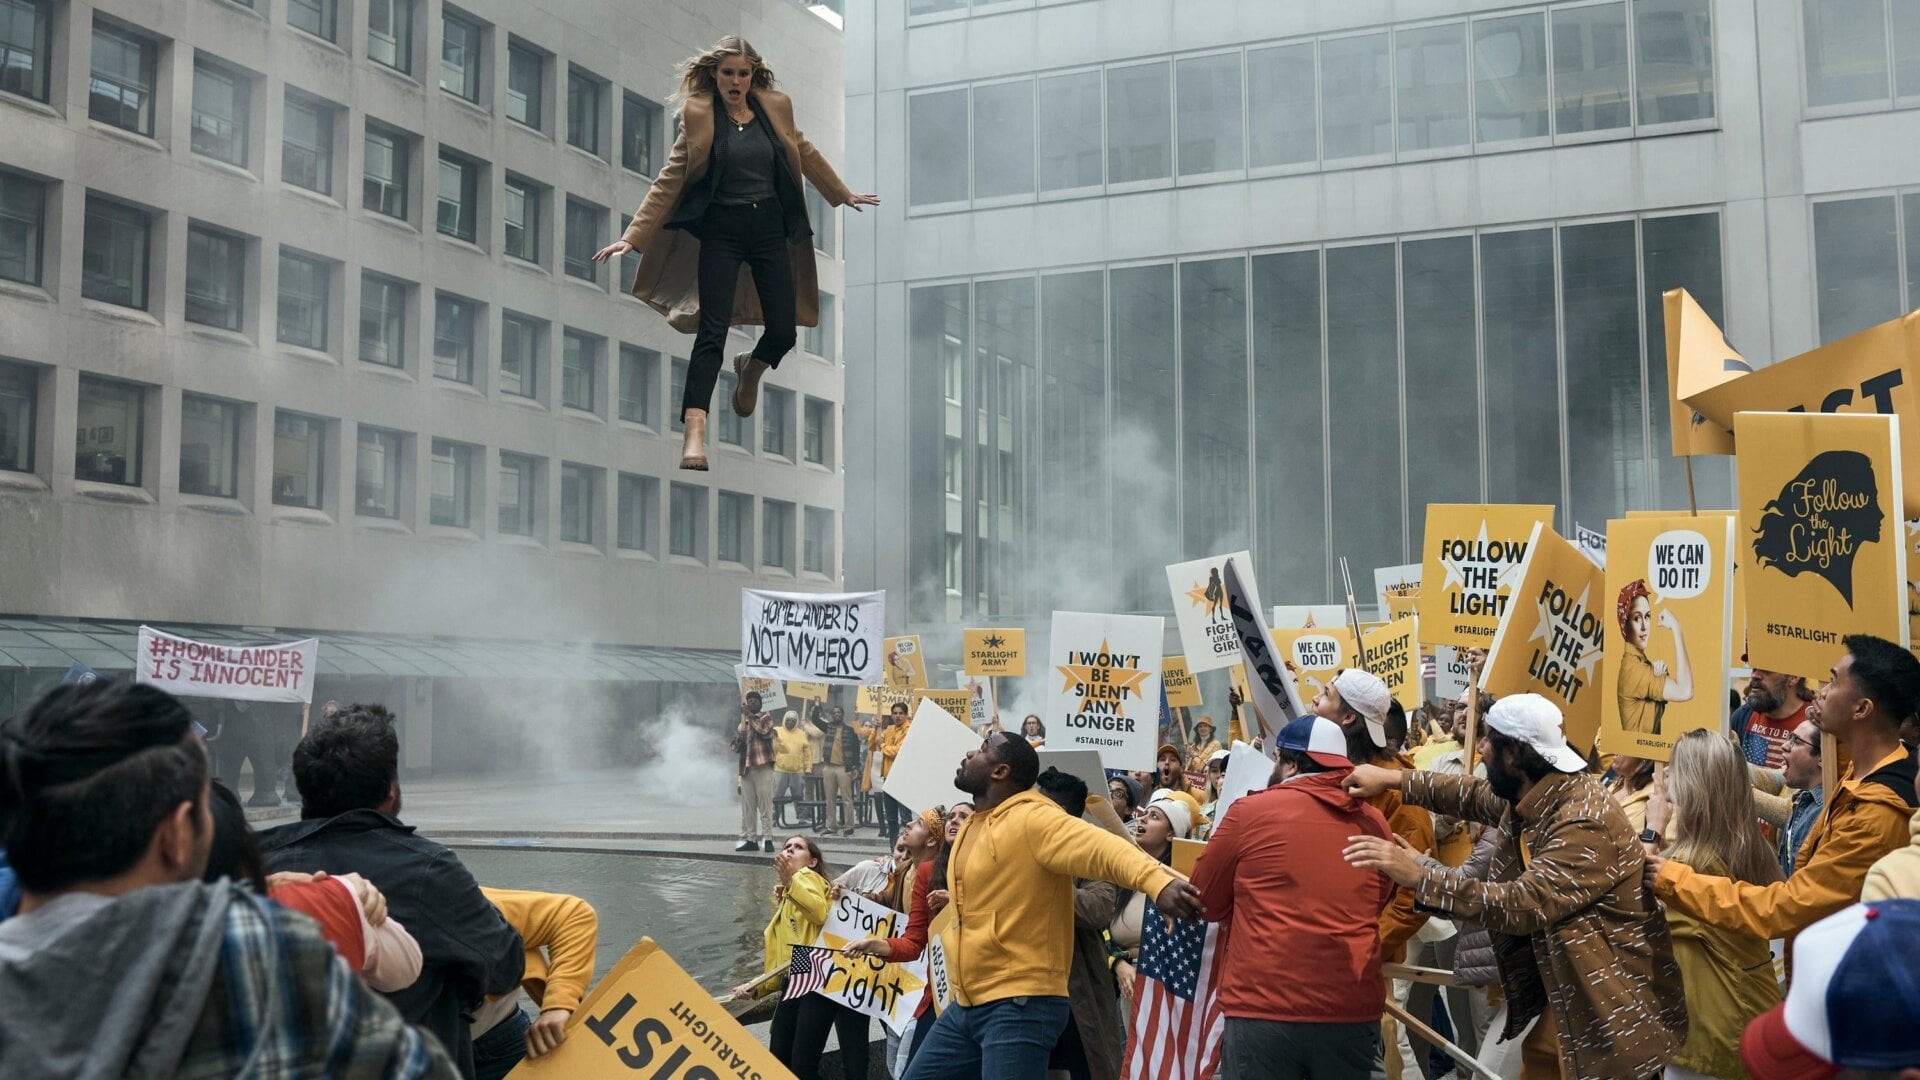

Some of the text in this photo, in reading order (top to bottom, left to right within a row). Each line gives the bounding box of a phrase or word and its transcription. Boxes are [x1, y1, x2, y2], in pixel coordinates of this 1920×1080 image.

[1791, 478, 1869, 517] Follow
[1809, 513, 1829, 529] the
[1441, 539, 1529, 564] FOLLOW
[1655, 544, 1704, 565] WE CAN
[1786, 523, 1852, 568] Light
[1462, 566, 1499, 590] THE
[1659, 567, 1699, 589] DO IT!
[1450, 592, 1509, 617] LIGHT
[761, 600, 859, 633] HOMELANDER IS
[1205, 622, 1235, 637] FIGH
[1212, 632, 1238, 643] LIKE A
[1454, 625, 1498, 637] #STARLIGH
[1767, 623, 1837, 644] #STARLIGHT
[150, 637, 303, 668] #HOMELANDER
[747, 623, 868, 675] NOT MY HERO
[1297, 641, 1336, 653] WE CAN
[1549, 625, 1584, 670] THE
[1069, 651, 1140, 669] I WON'T
[1302, 654, 1334, 666] DO IT!
[1447, 662, 1469, 675] LON
[152, 659, 303, 689] IS INNOCENT
[1091, 668, 1110, 683] BE
[1163, 669, 1185, 679] LIEVE
[1164, 677, 1192, 687] RLIGHT
[1528, 649, 1583, 703] LIGHT
[1075, 683, 1130, 700] SILENT
[1082, 700, 1121, 715] ANY
[1066, 713, 1135, 732] LONGER
[1769, 727, 1780, 737] TO
[1075, 736, 1124, 747] #STARLIGHT
[1636, 739, 1666, 749] #STARLIGHT
